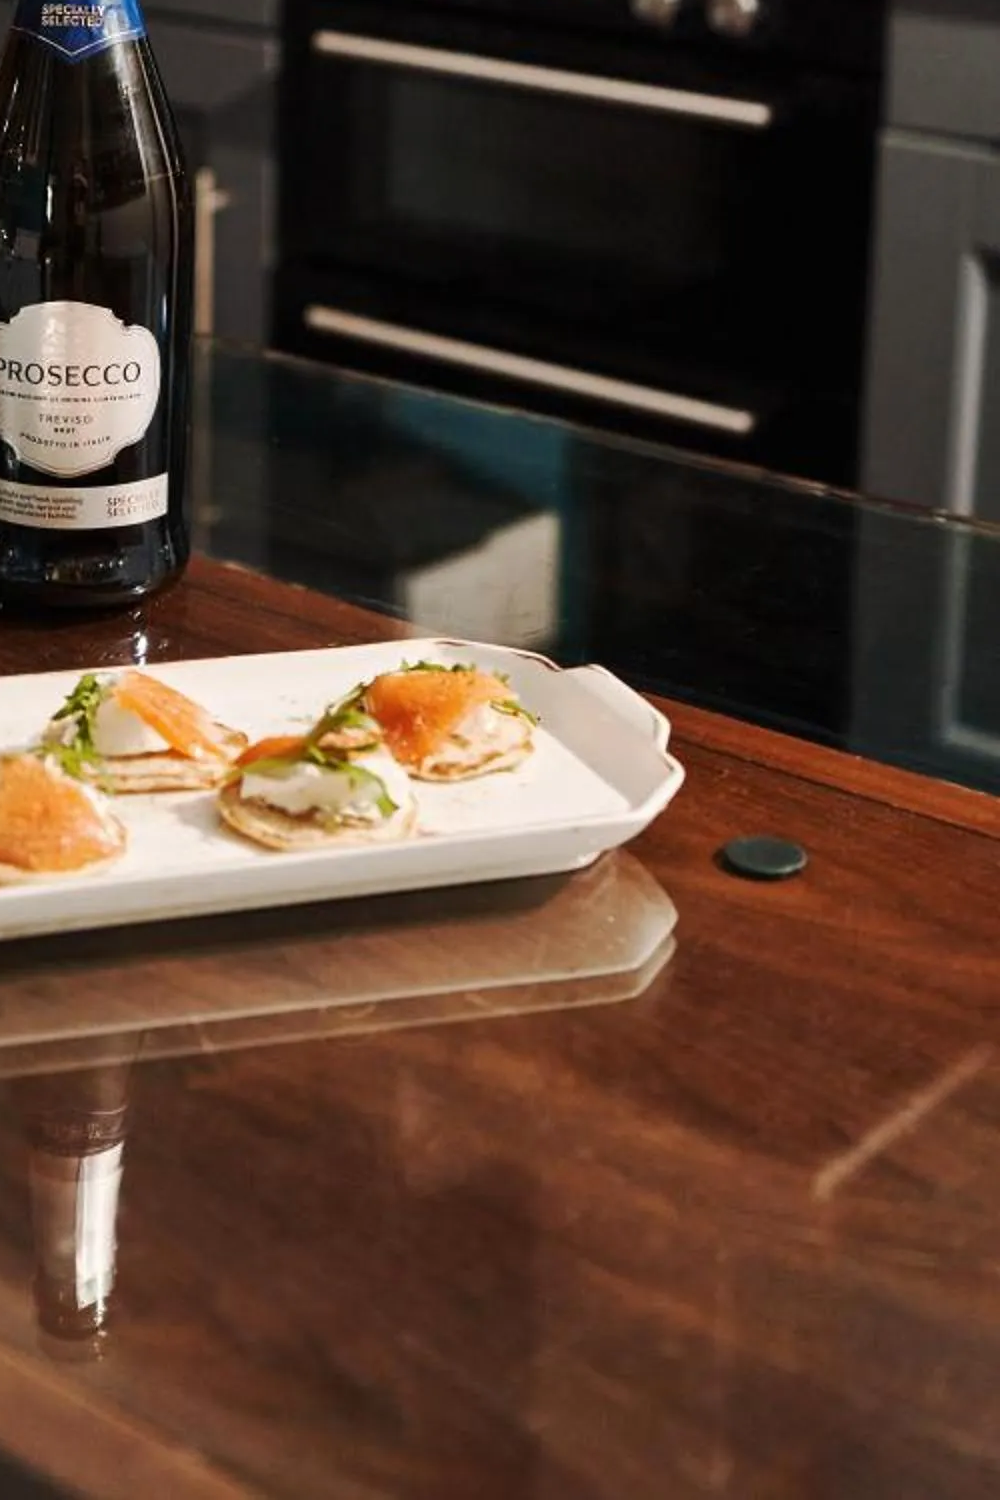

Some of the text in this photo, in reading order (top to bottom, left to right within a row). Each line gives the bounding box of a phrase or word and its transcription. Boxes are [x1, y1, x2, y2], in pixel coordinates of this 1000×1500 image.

[41, 3, 104, 16] SPECIALLY
[41, 16, 104, 27] SELECTED
[39, 413, 94, 425] TREVISO
